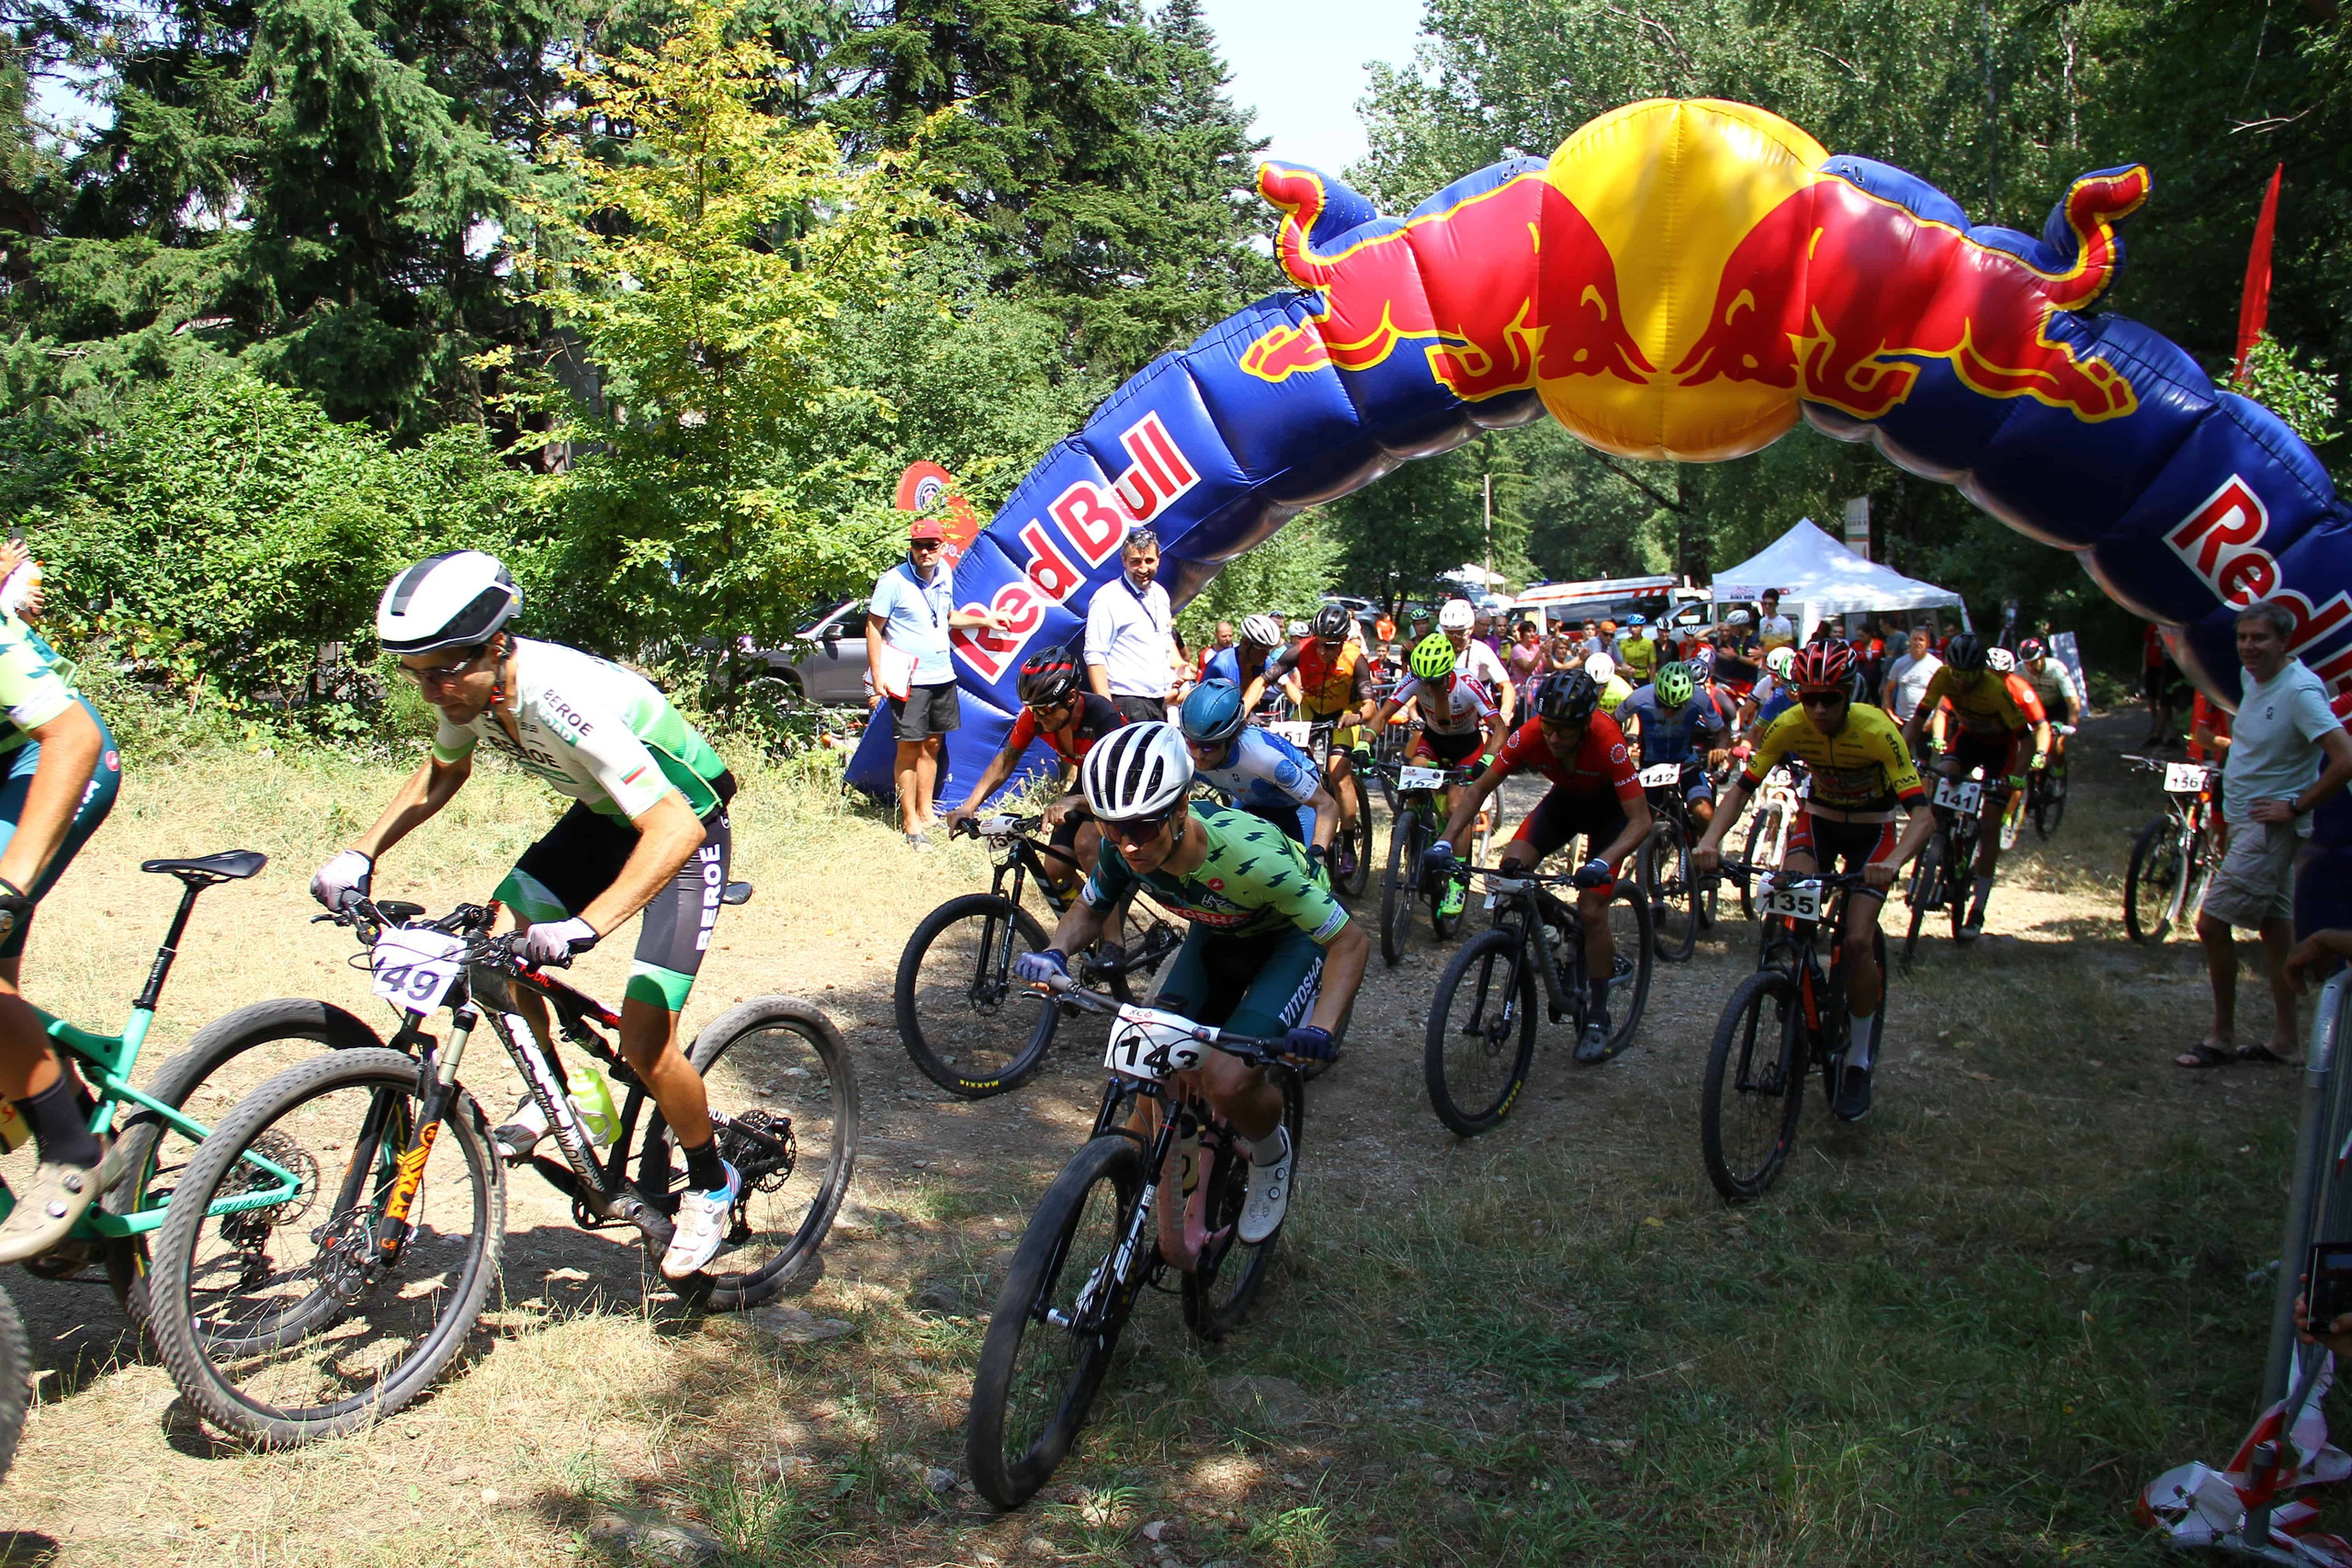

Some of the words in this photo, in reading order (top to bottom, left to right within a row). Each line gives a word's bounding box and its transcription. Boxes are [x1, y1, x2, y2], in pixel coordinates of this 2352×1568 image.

[949, 517, 1087, 685] Red
[1046, 410, 1202, 570] Bull
[543, 689, 594, 737] BEROE
[1939, 790, 1973, 809] 141
[695, 843, 722, 951] BEROE
[1762, 890, 1815, 916] 135
[1278, 955, 1324, 1028] VITOSHA
[1120, 1034, 1200, 1075] 143
[959, 1078, 1000, 1089] MAXXIS
[212, 1194, 284, 1213] SPECIALIZED
[386, 1163, 423, 1224] FOX
